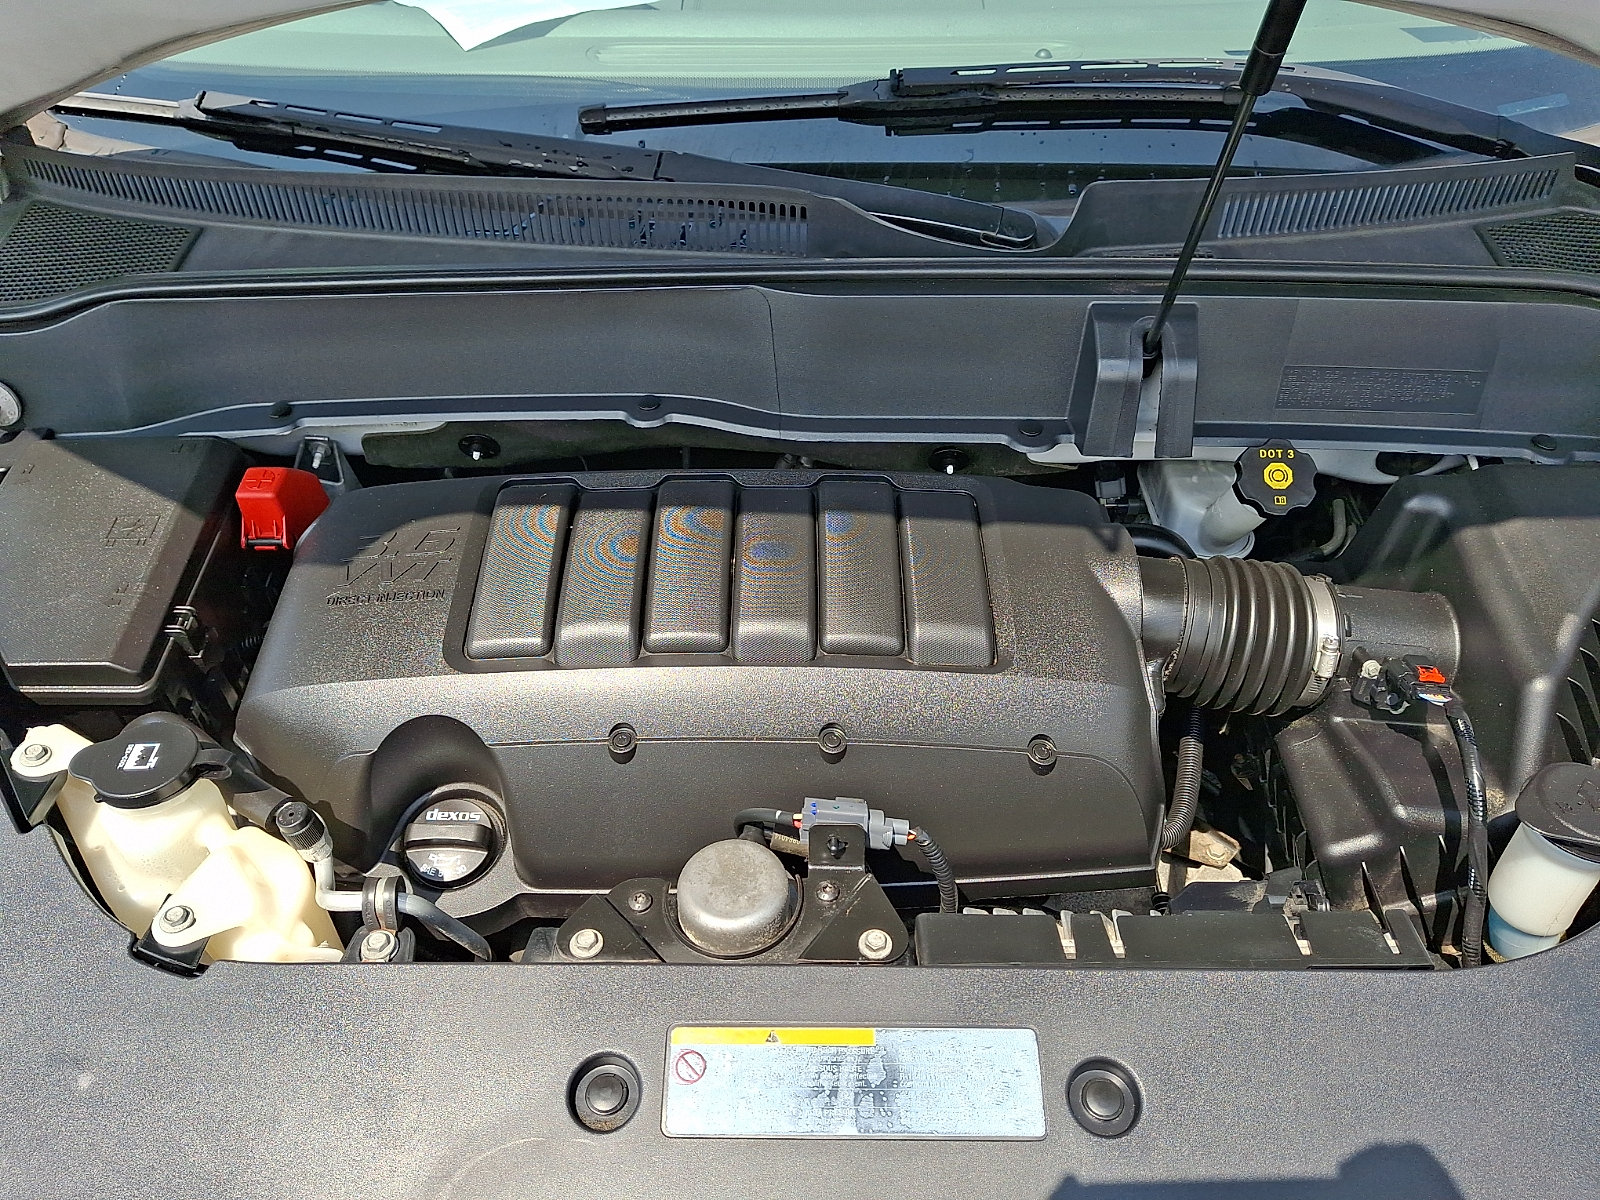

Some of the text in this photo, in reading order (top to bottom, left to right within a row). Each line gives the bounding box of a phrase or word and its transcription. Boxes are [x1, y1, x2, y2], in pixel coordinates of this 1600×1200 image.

[1259, 449, 1295, 459] DOT 3
[326, 588, 446, 606] DIRECT INJECTION
[425, 808, 483, 821] dexos
[419, 863, 437, 877] SAE
